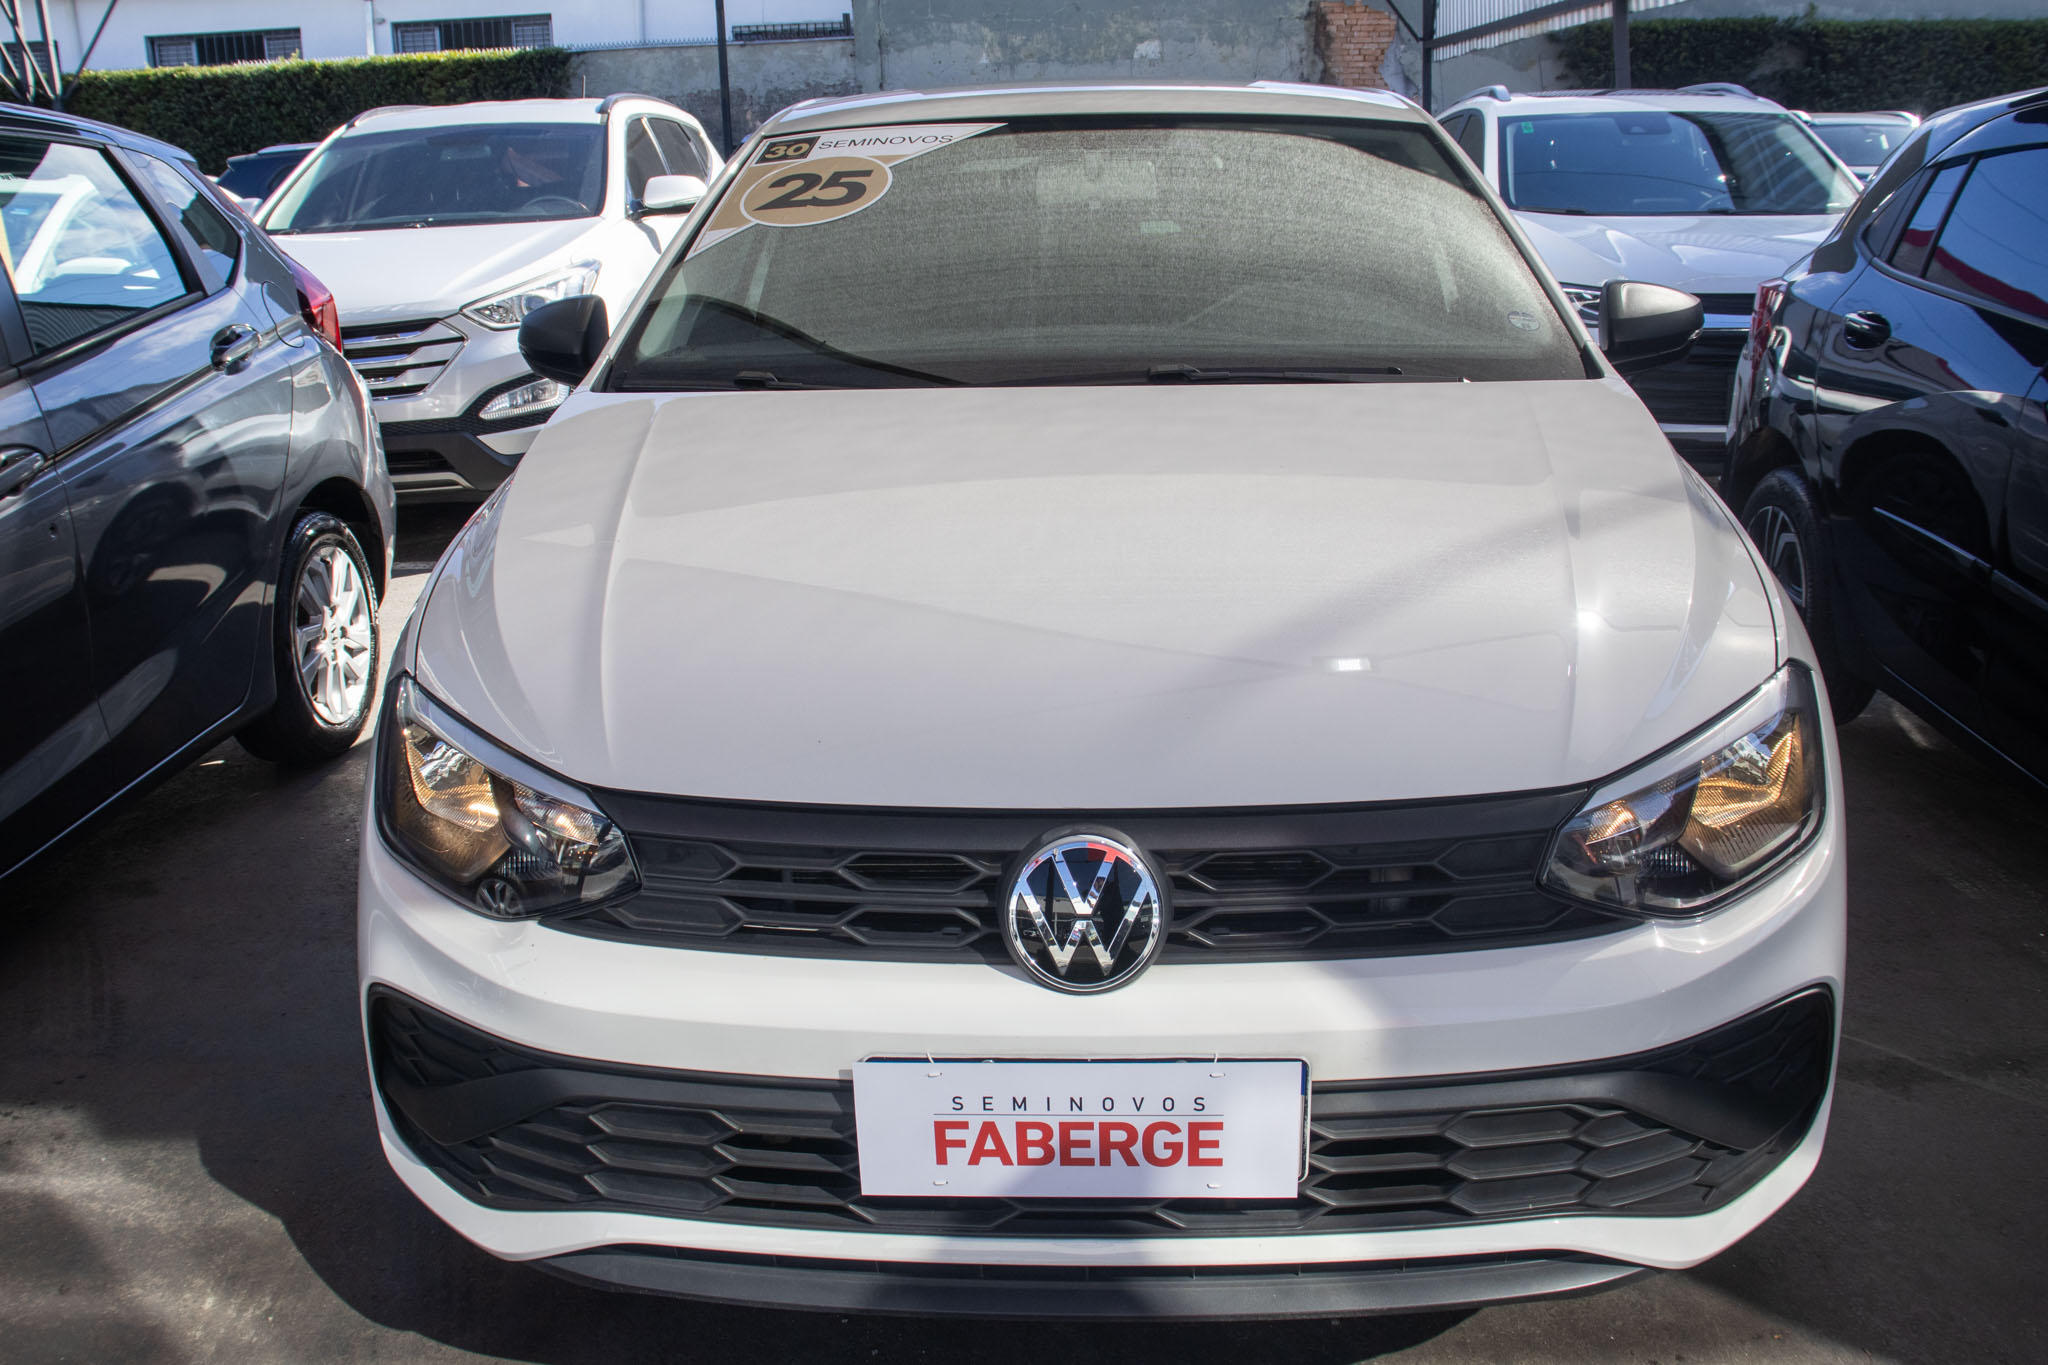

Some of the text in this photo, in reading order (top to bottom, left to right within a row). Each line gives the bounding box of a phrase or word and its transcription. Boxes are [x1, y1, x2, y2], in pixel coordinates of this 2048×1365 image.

[764, 142, 810, 159] 30
[819, 135, 954, 150] SEMINOVOS
[752, 169, 874, 212] 25
[951, 1096, 1207, 1112] SEMINOVOS
[933, 1120, 1224, 1168] FABERGE
